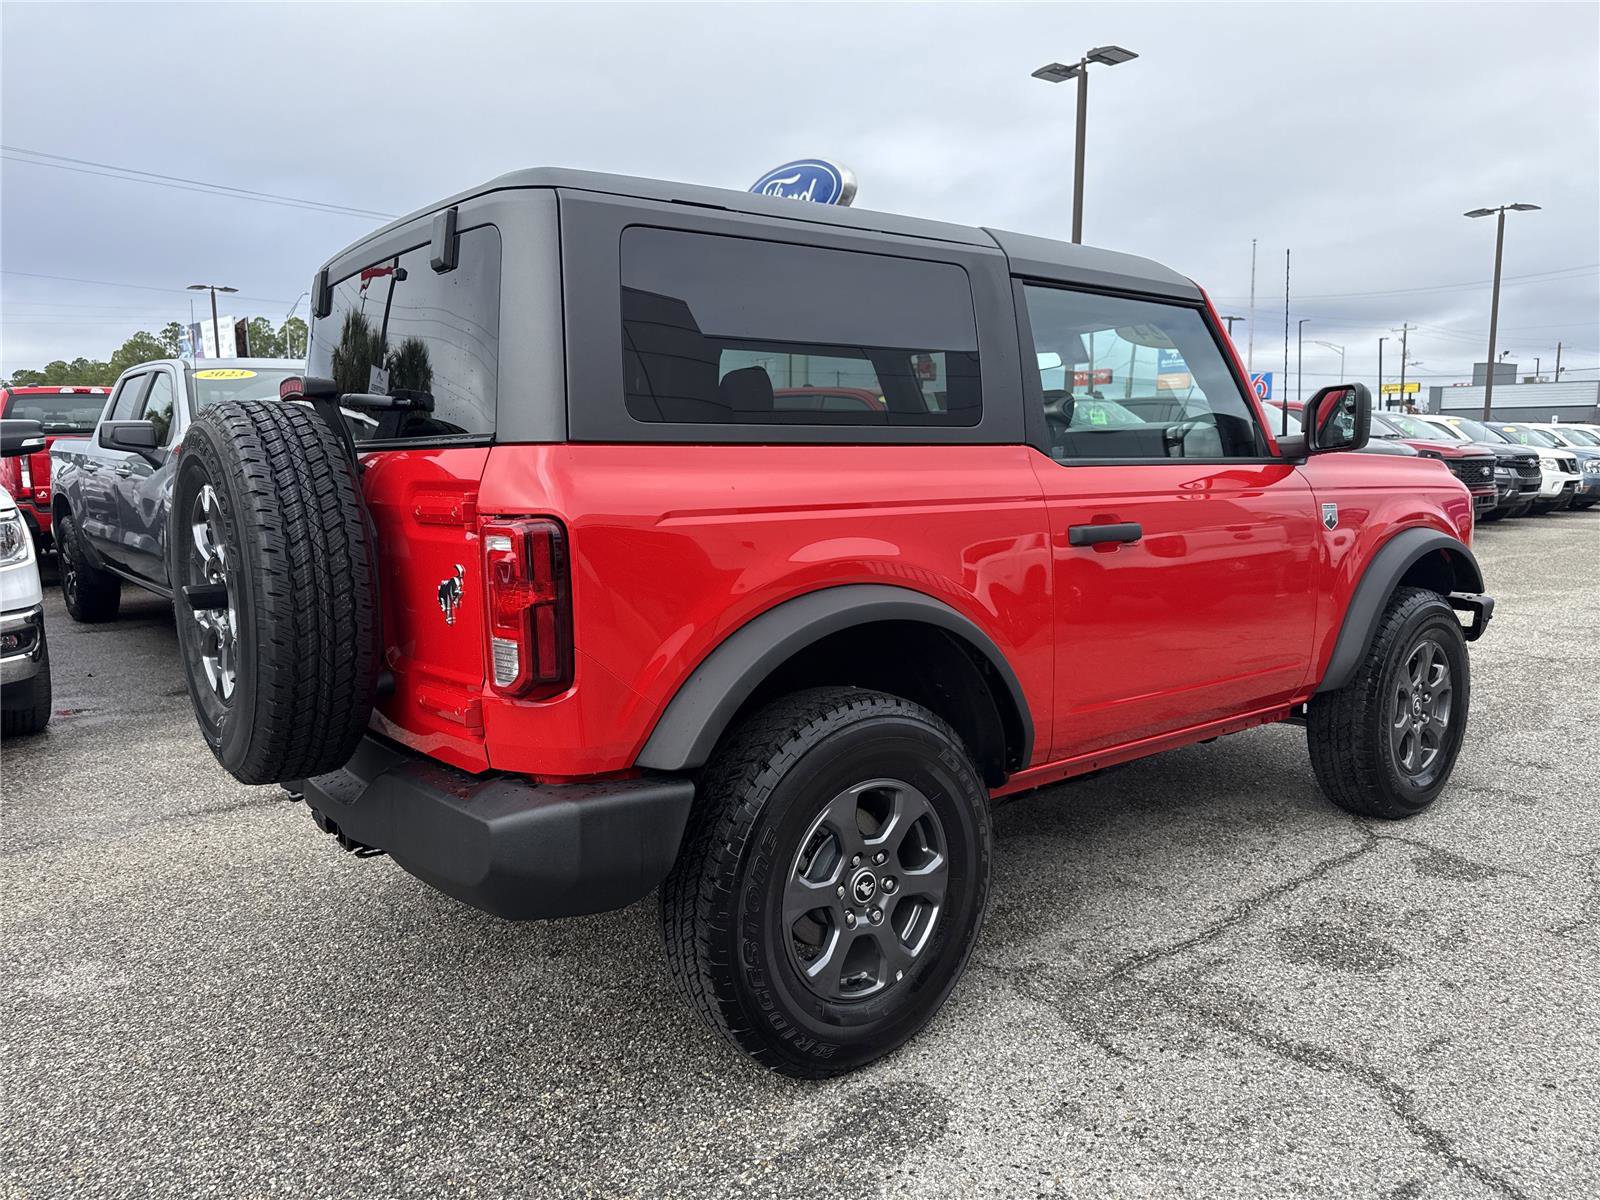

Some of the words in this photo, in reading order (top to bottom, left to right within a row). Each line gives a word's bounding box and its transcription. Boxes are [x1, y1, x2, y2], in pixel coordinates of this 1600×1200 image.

[203, 370, 246, 378] 2023
[1251, 374, 1268, 398] 6
[742, 826, 841, 1059] BRIDGESTONE
